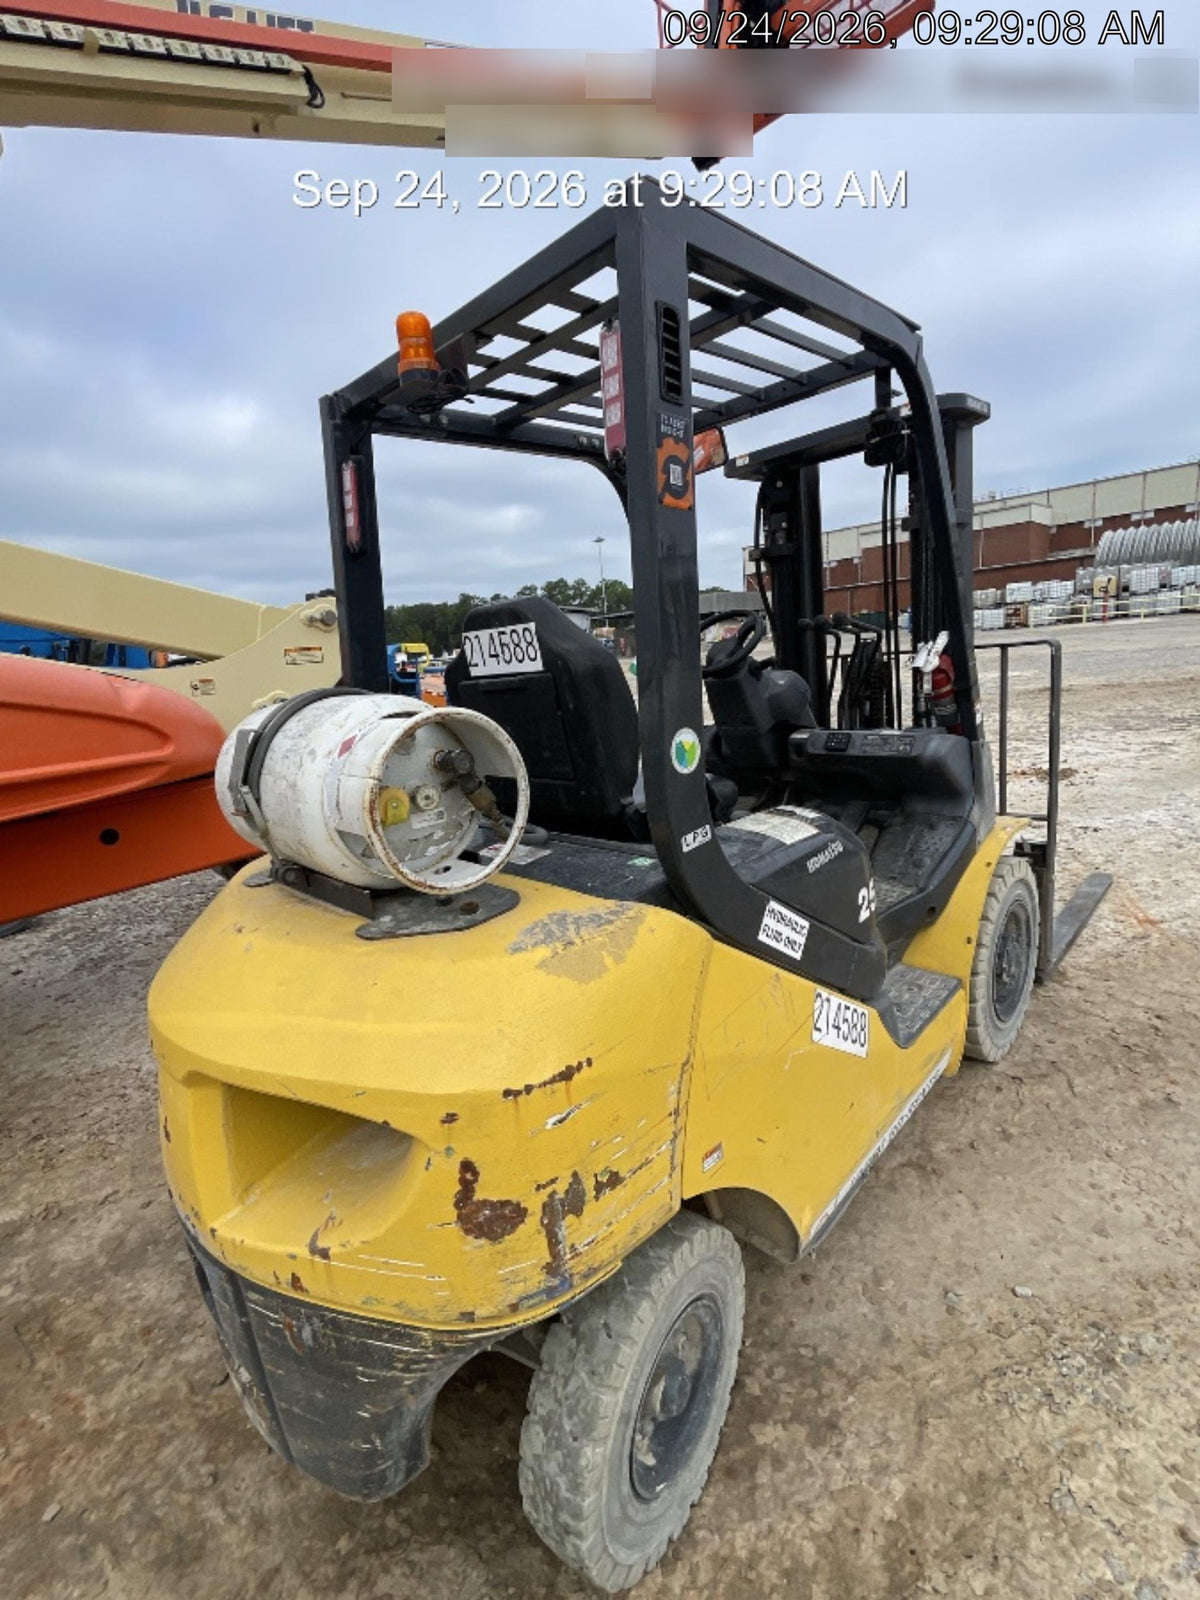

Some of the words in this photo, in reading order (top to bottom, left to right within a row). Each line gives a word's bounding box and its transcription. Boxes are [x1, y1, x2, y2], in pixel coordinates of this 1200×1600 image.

[463, 627, 537, 667] 214588
[683, 825, 709, 847] LPG
[806, 840, 844, 873] KOMATSU
[813, 991, 867, 1048] 214588
